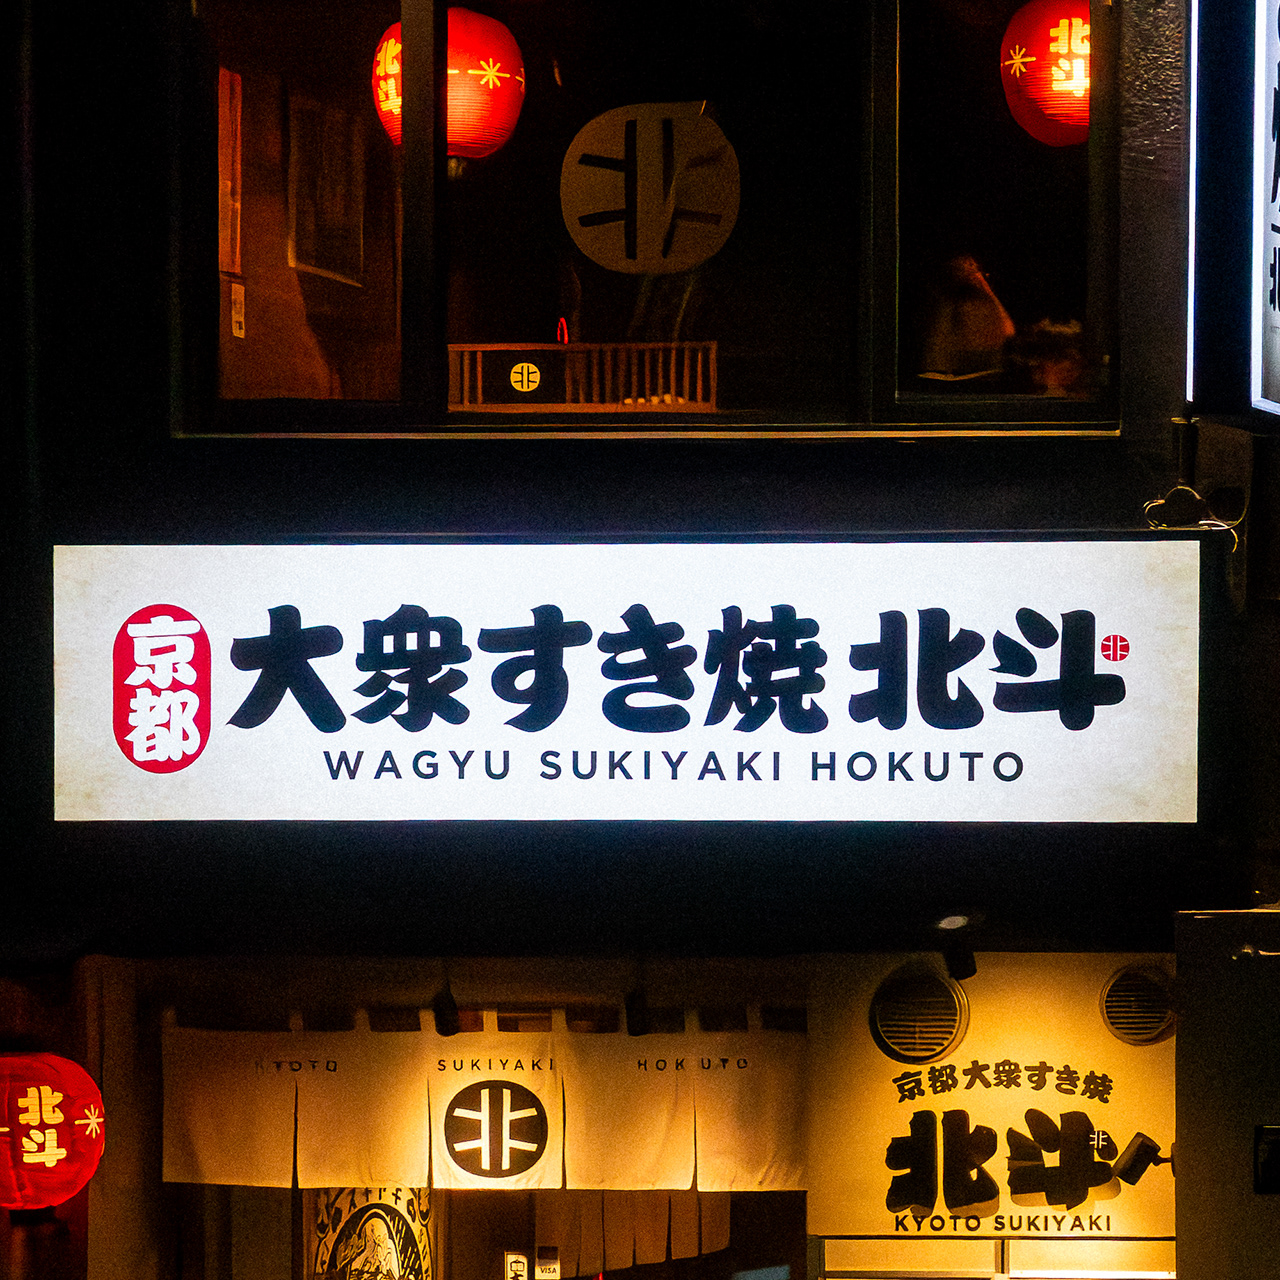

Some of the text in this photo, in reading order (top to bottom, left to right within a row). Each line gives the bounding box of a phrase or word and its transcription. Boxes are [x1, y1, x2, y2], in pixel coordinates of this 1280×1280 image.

[376, 38, 402, 114] 北斗
[1049, 18, 1091, 97] 北斗
[122, 616, 202, 764] 京都
[227, 603, 1128, 734] 大衆すき焼 北斗
[322, 750, 1026, 783] WAGYU SUKIYAKI HOKUTO
[436, 1057, 556, 1073] SUKIYAKI
[17, 1085, 68, 1168] 北斗
[885, 1108, 1118, 1216] 北斗
[894, 1215, 1112, 1232] KYOTO SUKIYAKI
